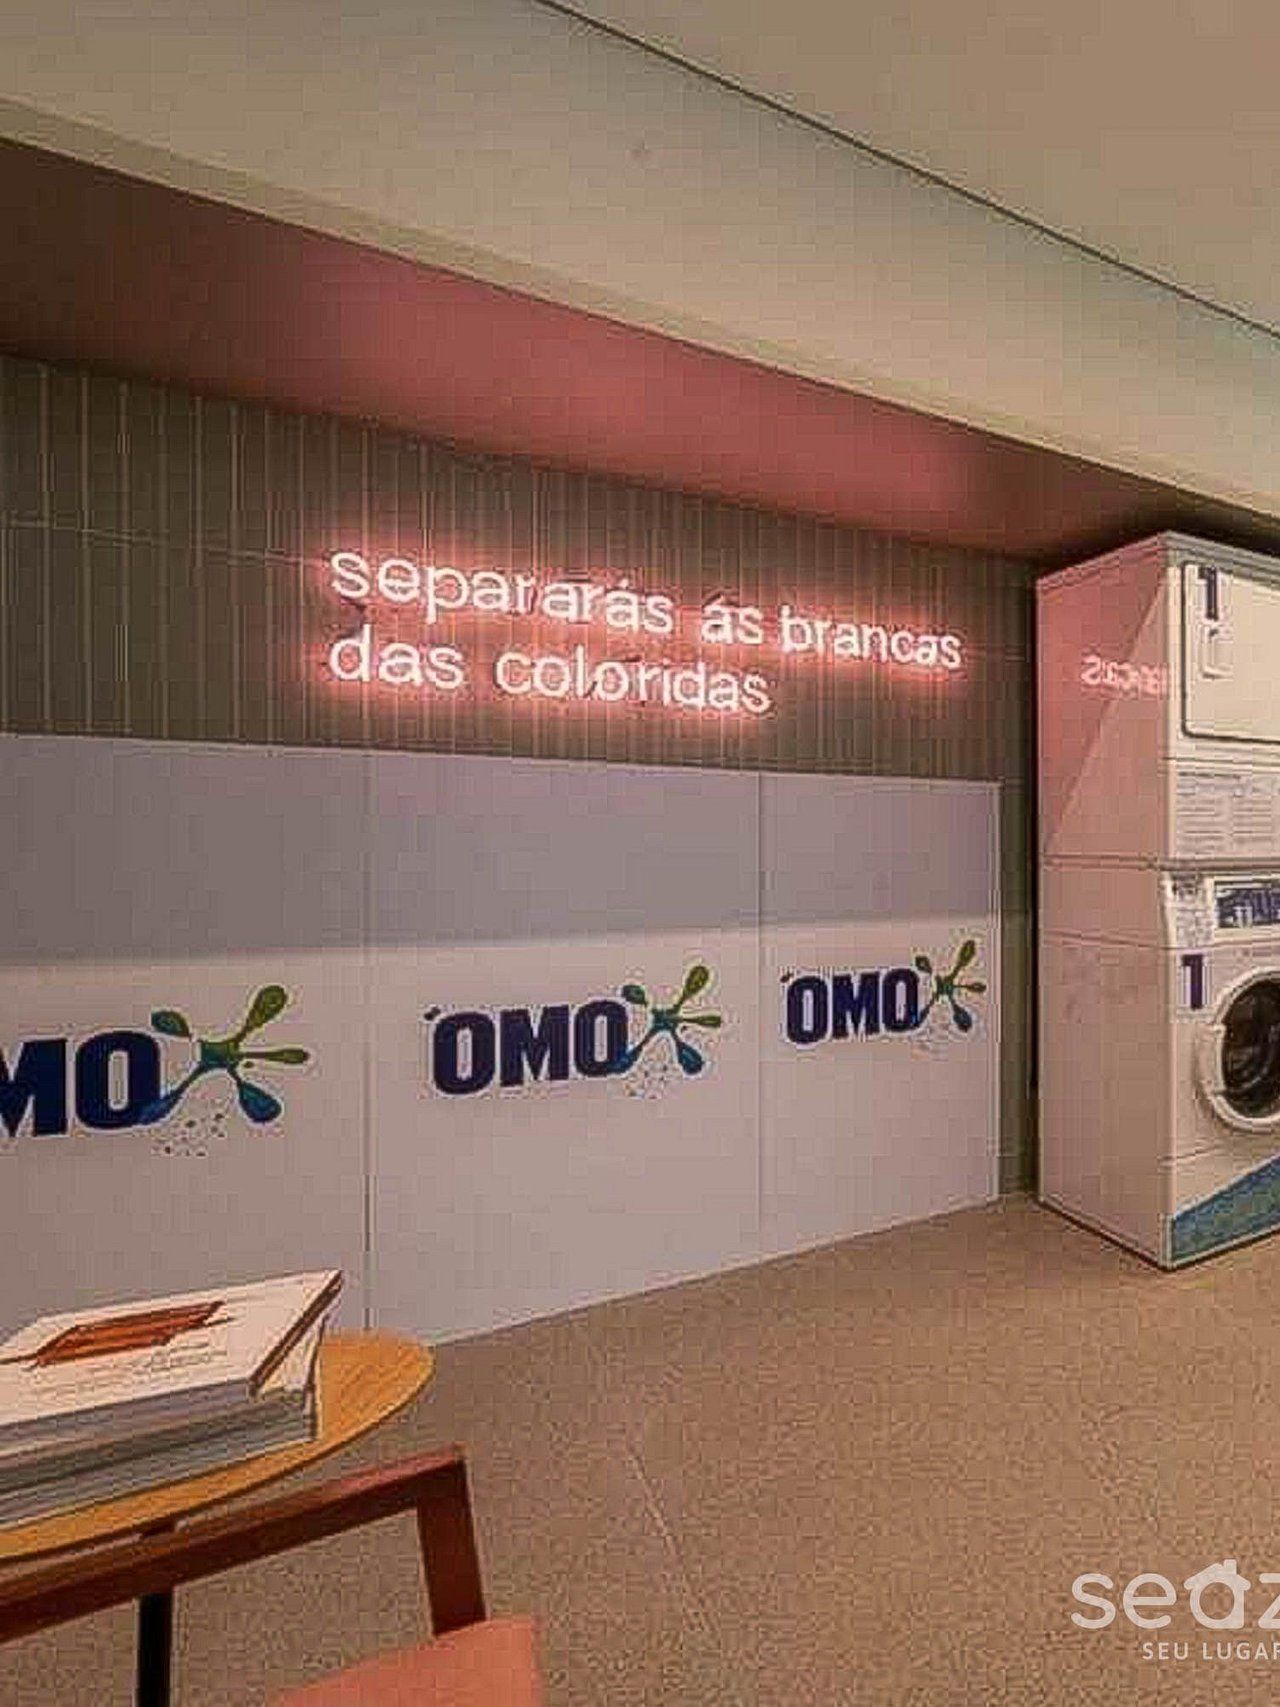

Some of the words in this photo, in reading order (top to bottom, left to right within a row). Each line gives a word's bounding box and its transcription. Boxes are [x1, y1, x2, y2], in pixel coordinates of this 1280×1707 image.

[331, 552, 675, 634] separarás
[778, 604, 961, 669] brancas
[1197, 565, 1218, 621] 1
[330, 623, 465, 688] das
[495, 645, 771, 713] coloridas
[786, 968, 920, 1044] OMO
[1181, 954, 1203, 1009] 1
[0, 1030, 165, 1137] MO
[433, 999, 632, 1095] OMO
